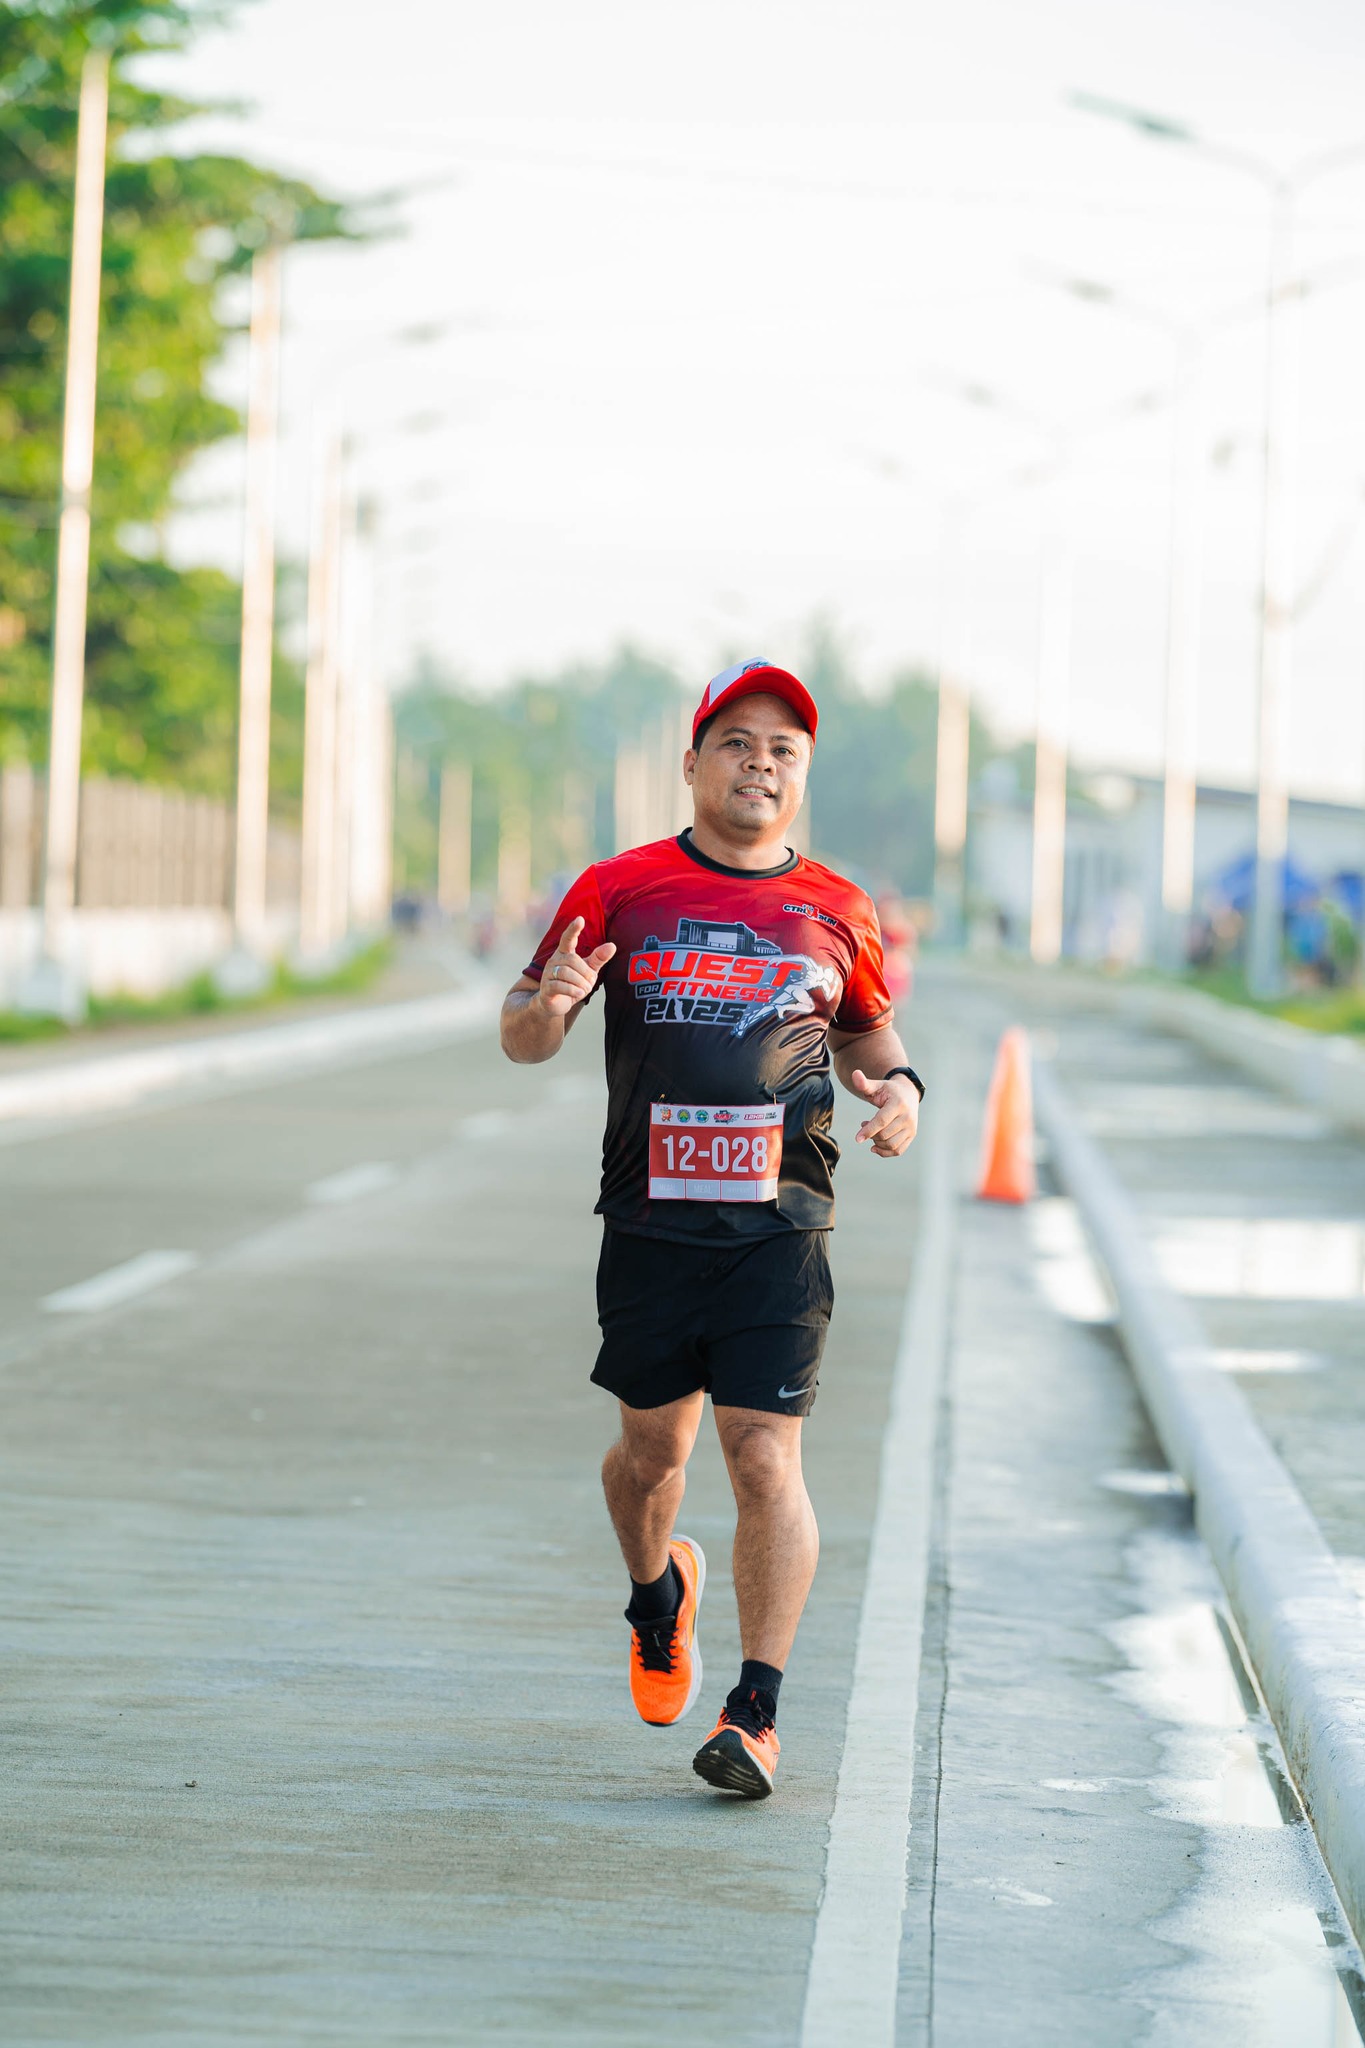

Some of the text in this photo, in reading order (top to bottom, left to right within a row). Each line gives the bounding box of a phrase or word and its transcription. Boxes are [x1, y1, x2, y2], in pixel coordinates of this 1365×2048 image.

[629, 951, 803, 987] QUEST
[639, 981, 776, 1003] FOR FITNESS
[645, 998, 748, 1024] 2025
[662, 1135, 768, 1173] 12-028
